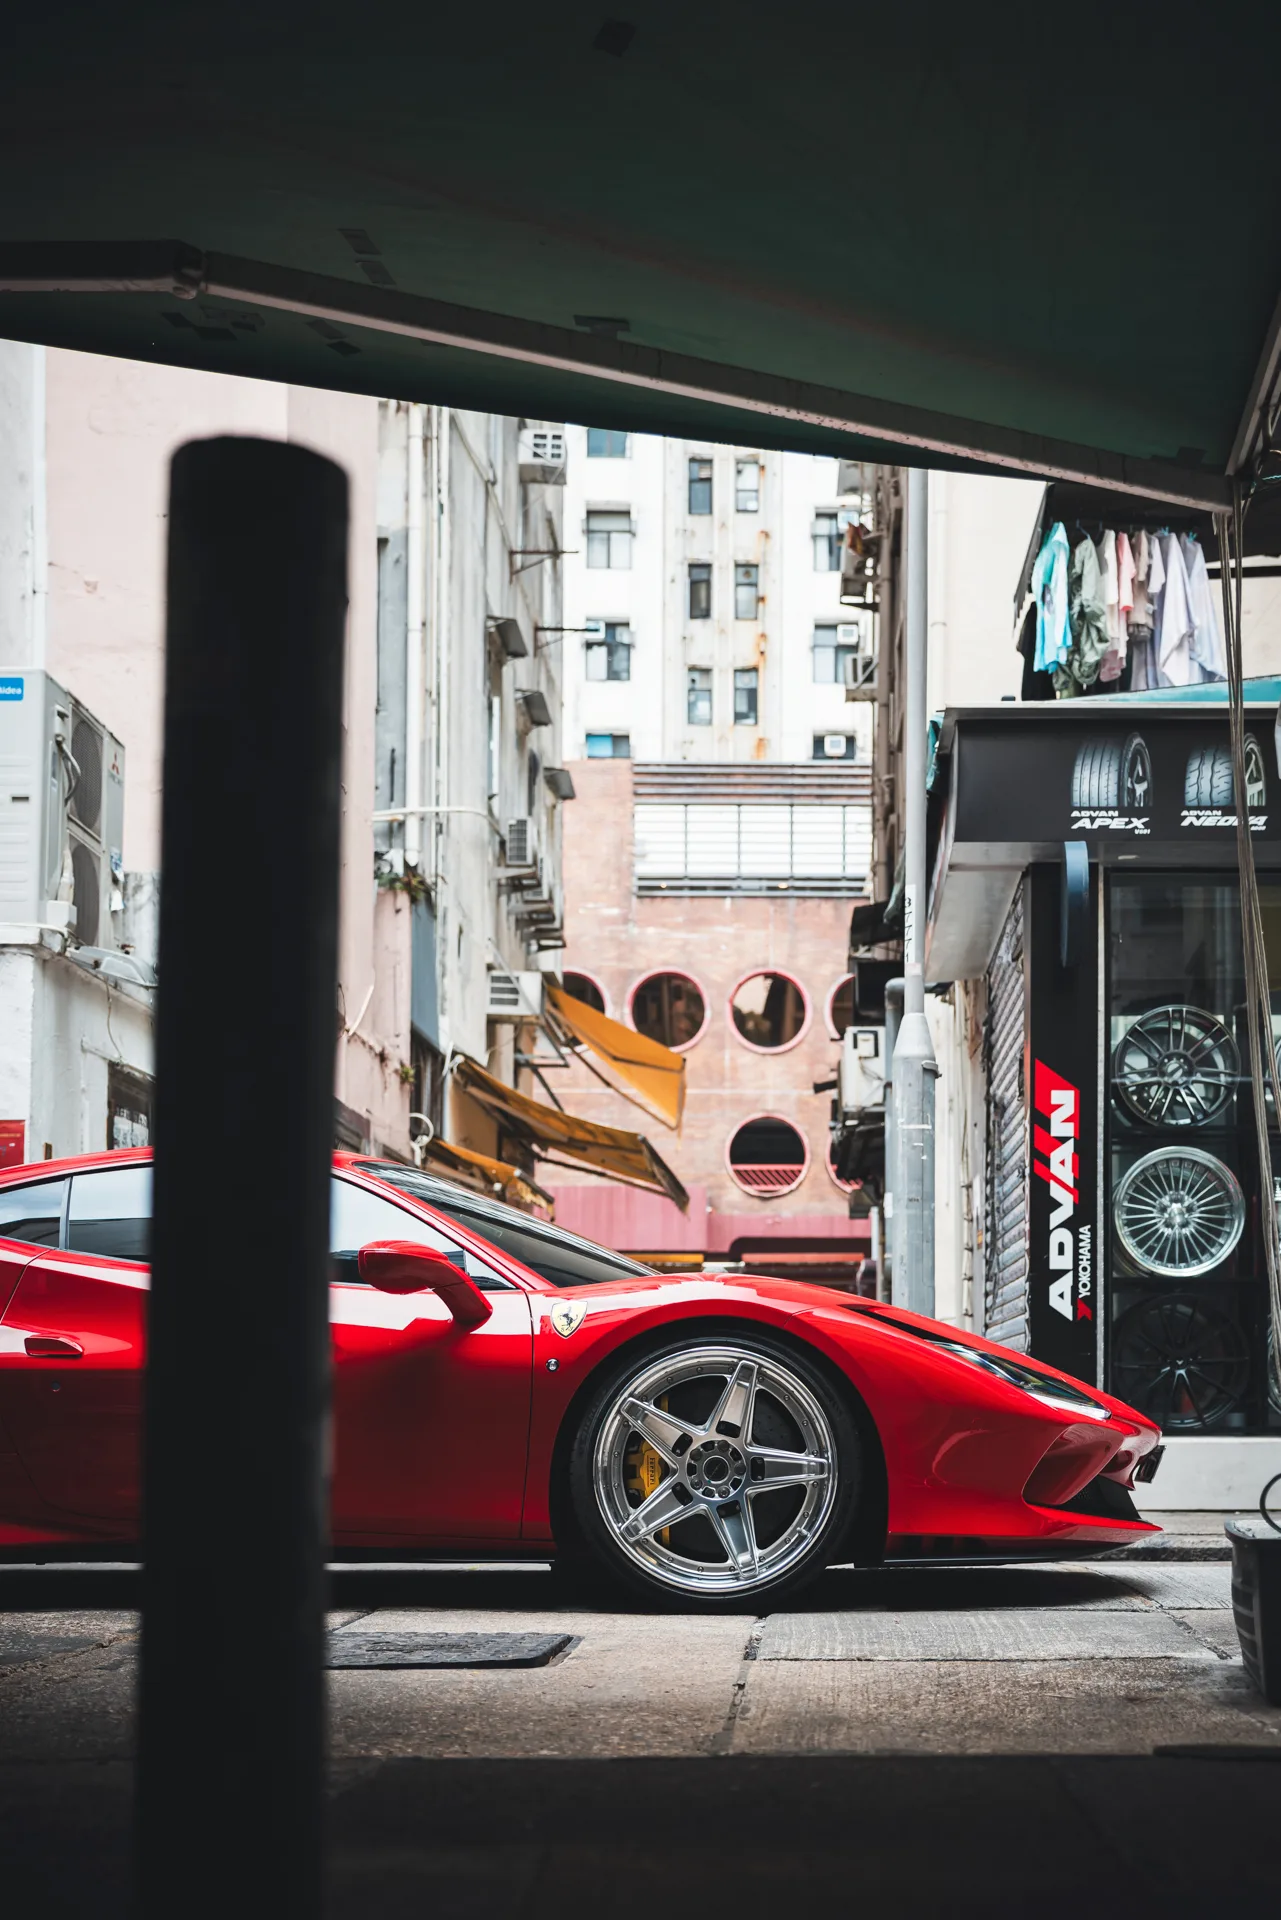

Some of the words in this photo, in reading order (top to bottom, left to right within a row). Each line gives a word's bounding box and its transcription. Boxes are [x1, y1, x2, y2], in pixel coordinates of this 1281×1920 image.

[1070, 817, 1150, 829] APEX
[1048, 1089, 1075, 1322] ADVAN
[1078, 1224, 1091, 1299] YOKOHAMA
